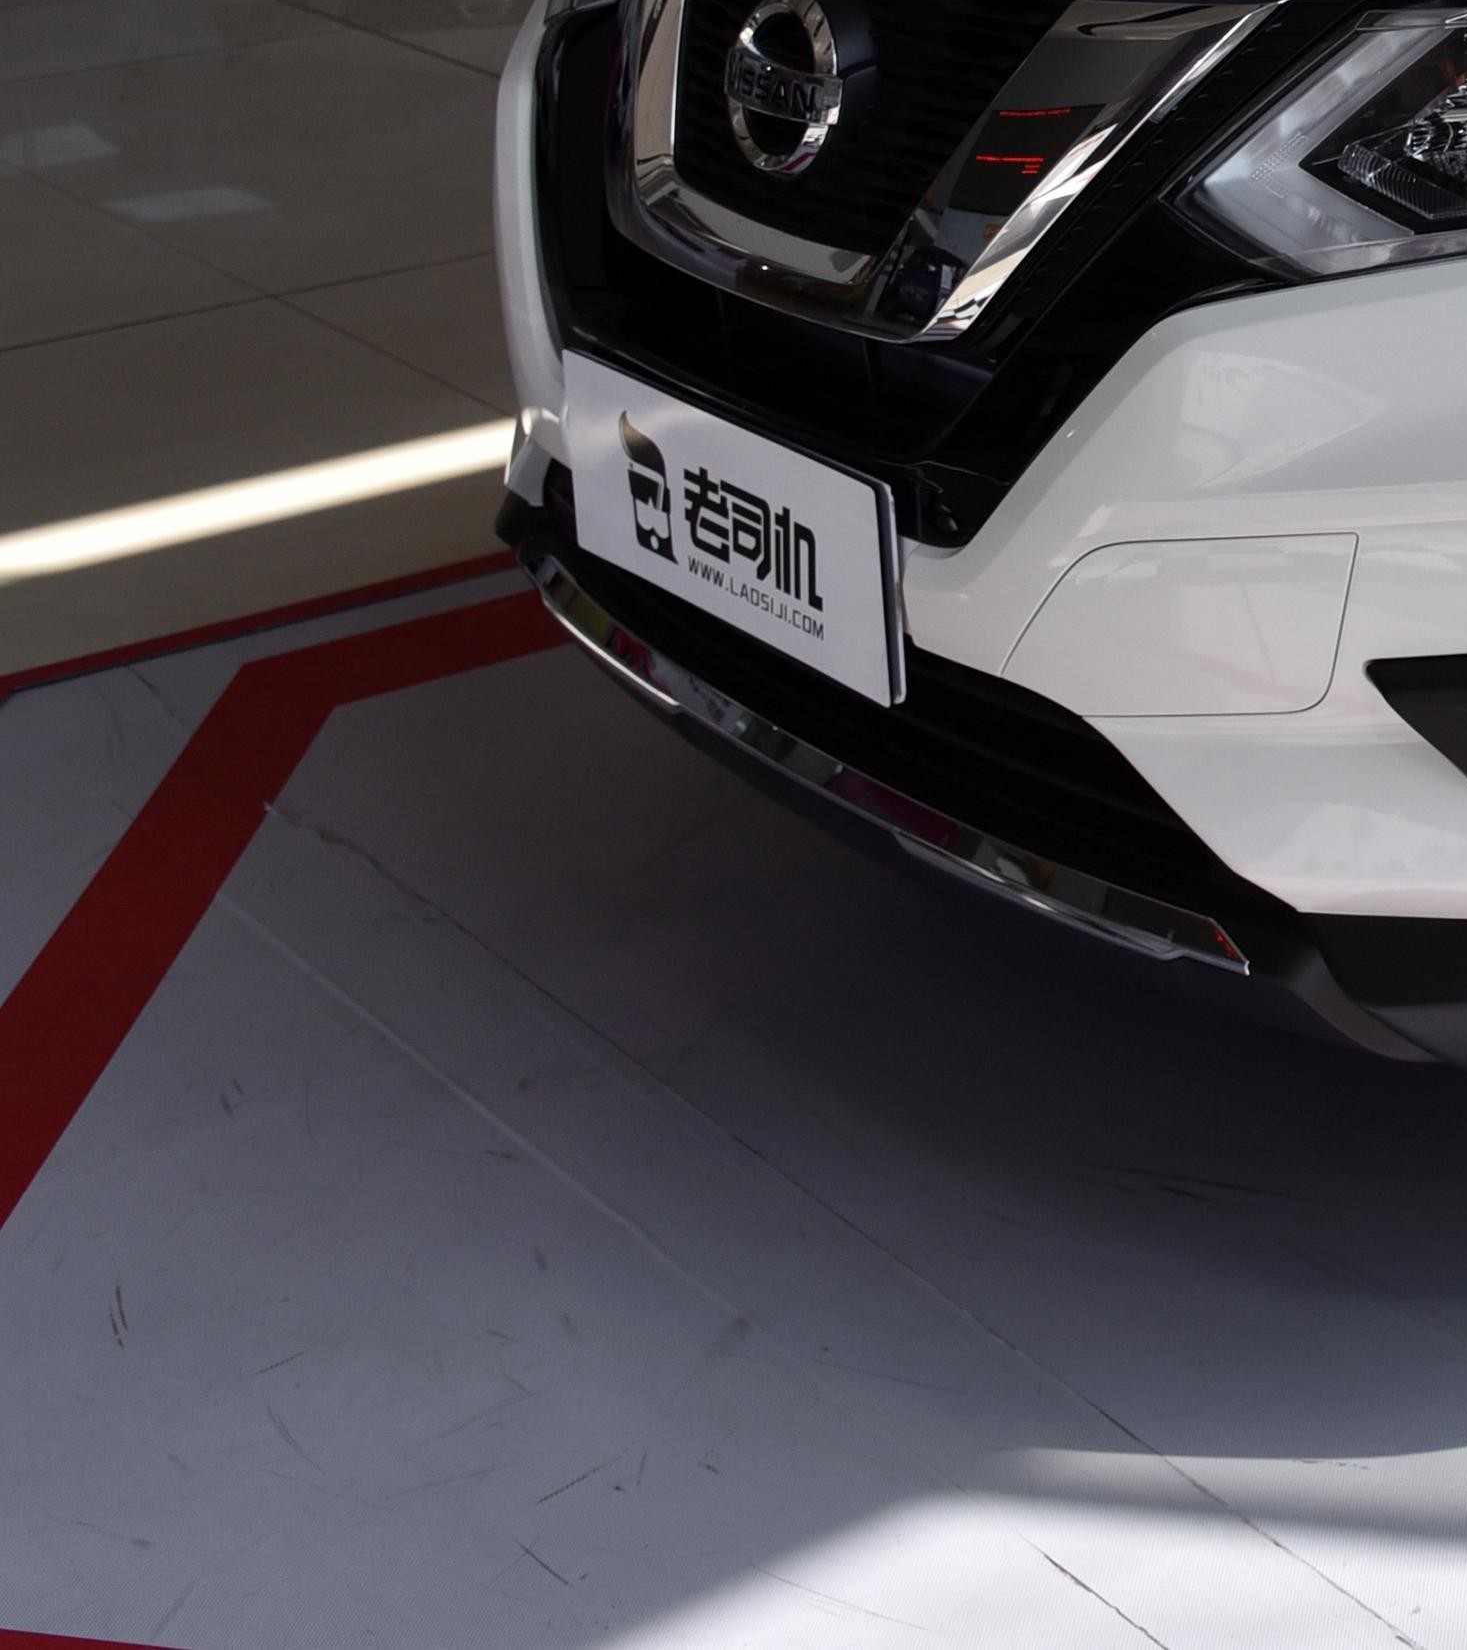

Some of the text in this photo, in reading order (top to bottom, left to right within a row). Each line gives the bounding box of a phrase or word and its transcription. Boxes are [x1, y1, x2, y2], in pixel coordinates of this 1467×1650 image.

[683, 466, 824, 613] 老司机
[687, 555, 825, 642] WWW.LAOSIJI.COM
